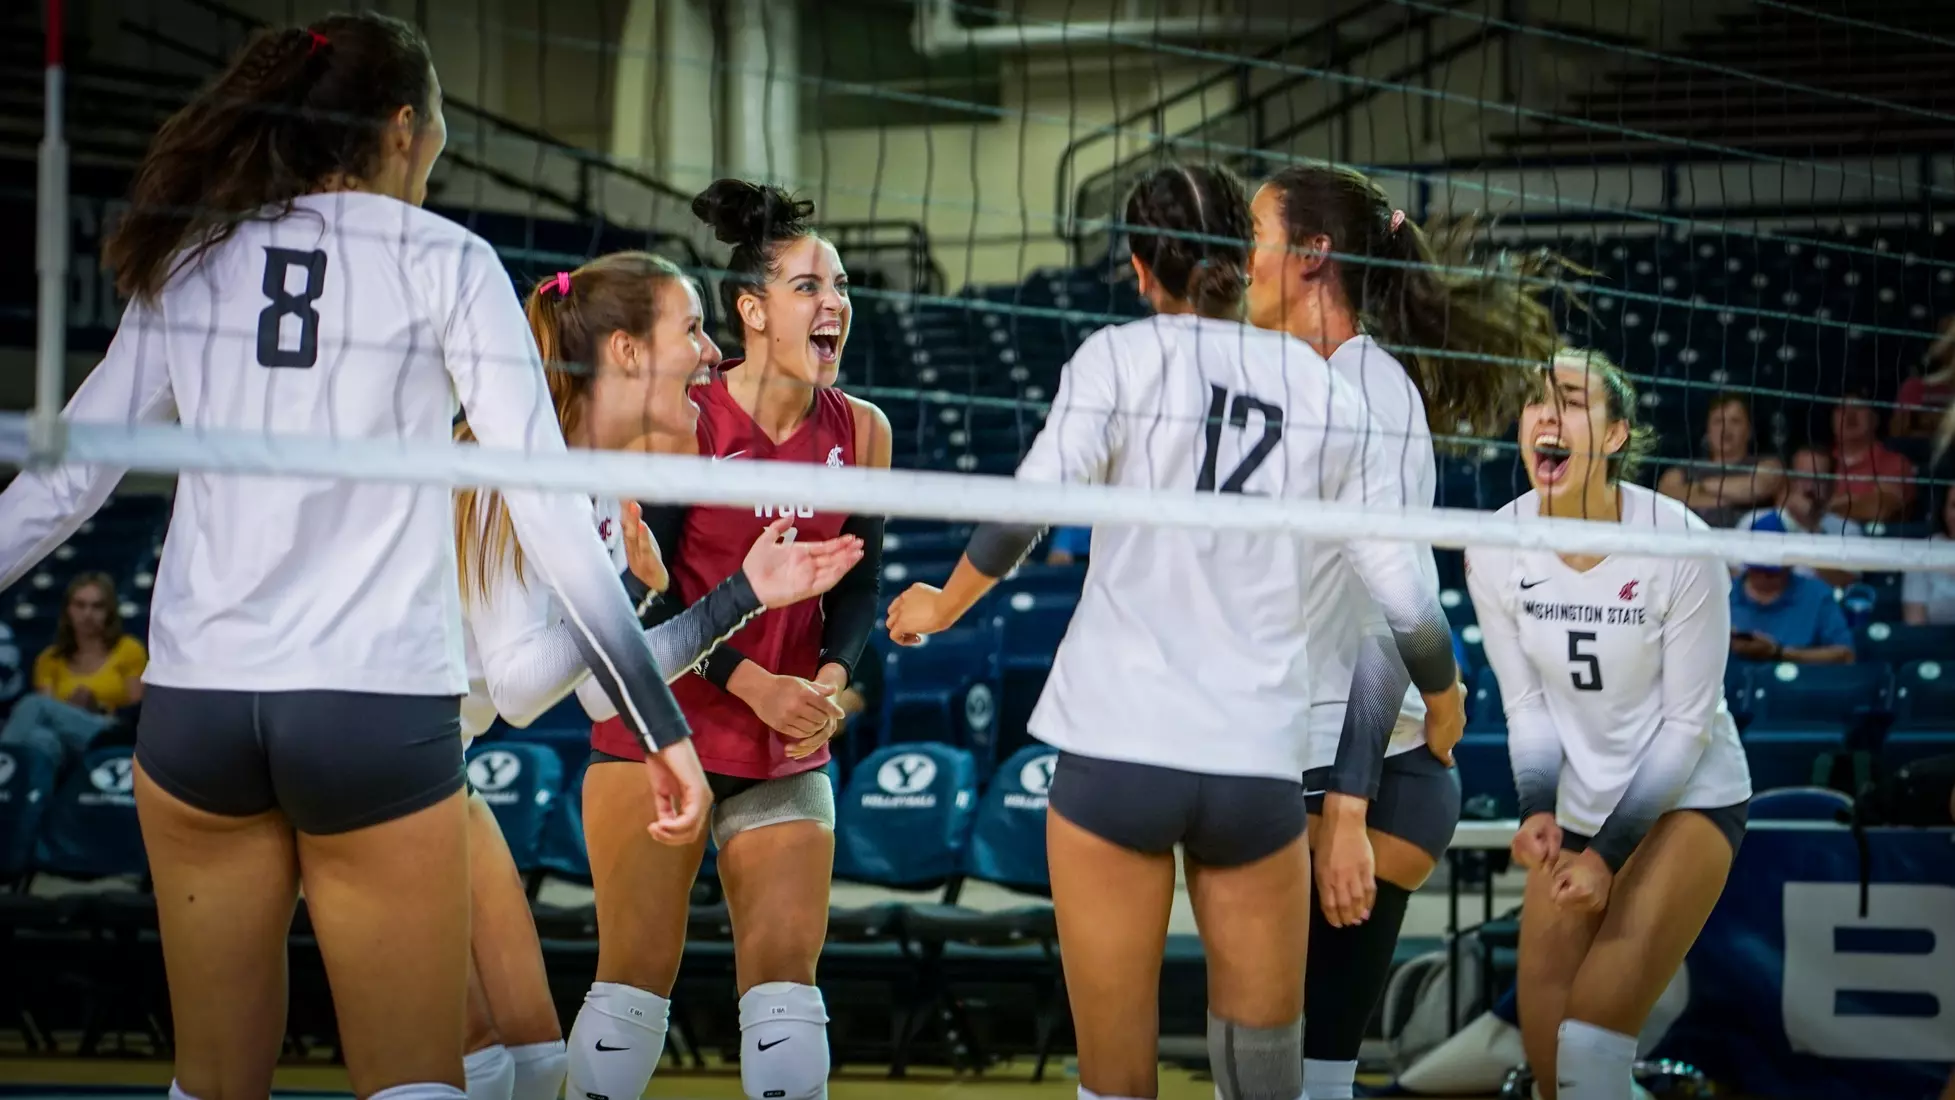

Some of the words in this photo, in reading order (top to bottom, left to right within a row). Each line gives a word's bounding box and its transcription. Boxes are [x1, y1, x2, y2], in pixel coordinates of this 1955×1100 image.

[256, 246, 328, 369] 8
[1195, 379, 1284, 496] 12
[1607, 605, 1647, 625] STATE
[1567, 629, 1604, 691] 5
[893, 760, 927, 789] Y
[1782, 881, 1955, 1063] B
